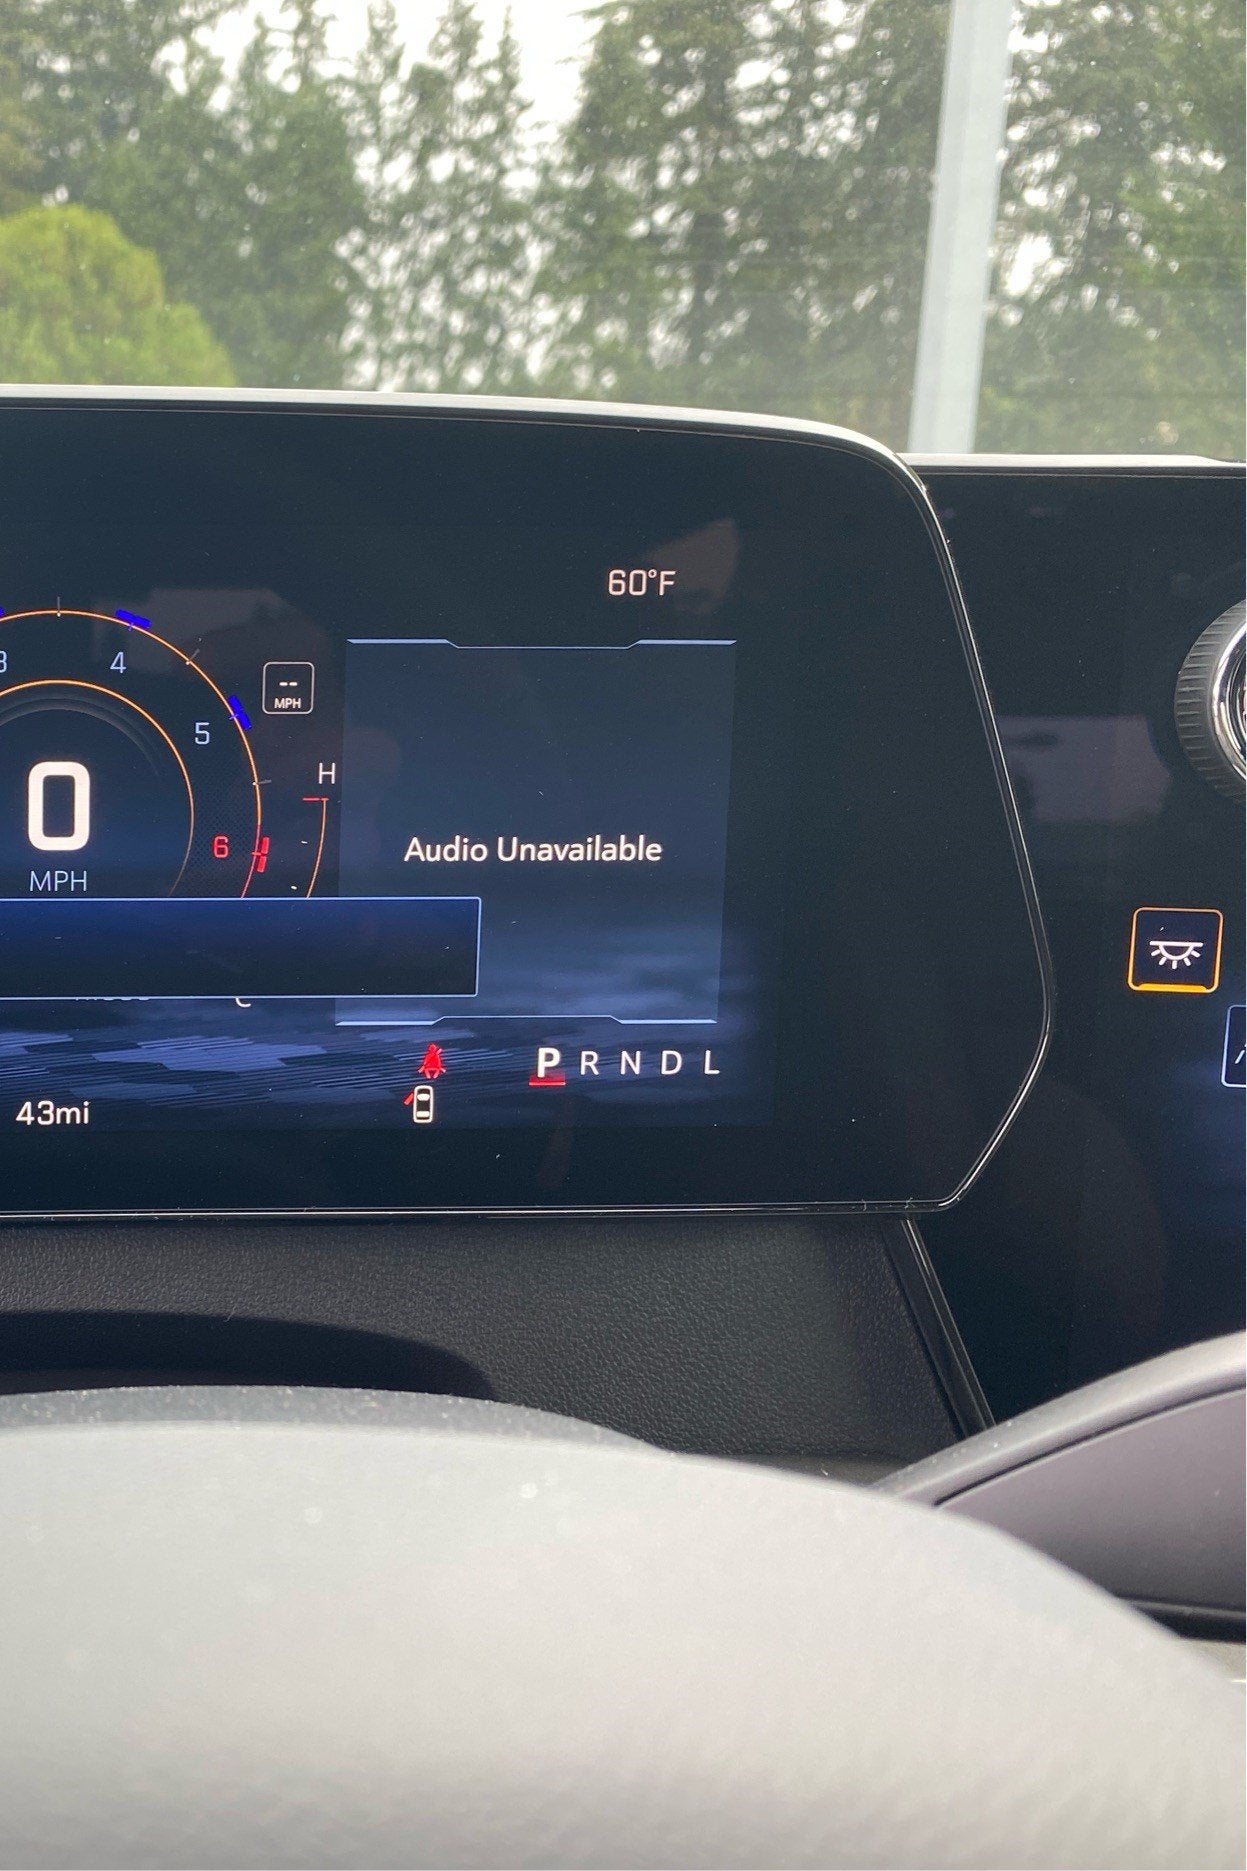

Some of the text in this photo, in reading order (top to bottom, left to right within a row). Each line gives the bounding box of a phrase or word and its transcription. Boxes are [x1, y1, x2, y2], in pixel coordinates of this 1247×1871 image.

[607, 568, 677, 596] 60°F
[109, 651, 127, 675] 4
[273, 697, 302, 709] MPH
[194, 721, 211, 745] 5
[318, 762, 337, 785] H
[27, 760, 92, 851] 0
[212, 835, 230, 858] 6
[403, 834, 664, 863] Audio Unavailable
[28, 870, 89, 893] MPH
[536, 1047, 721, 1078] P R N D L
[14, 1099, 91, 1127] 43mi
